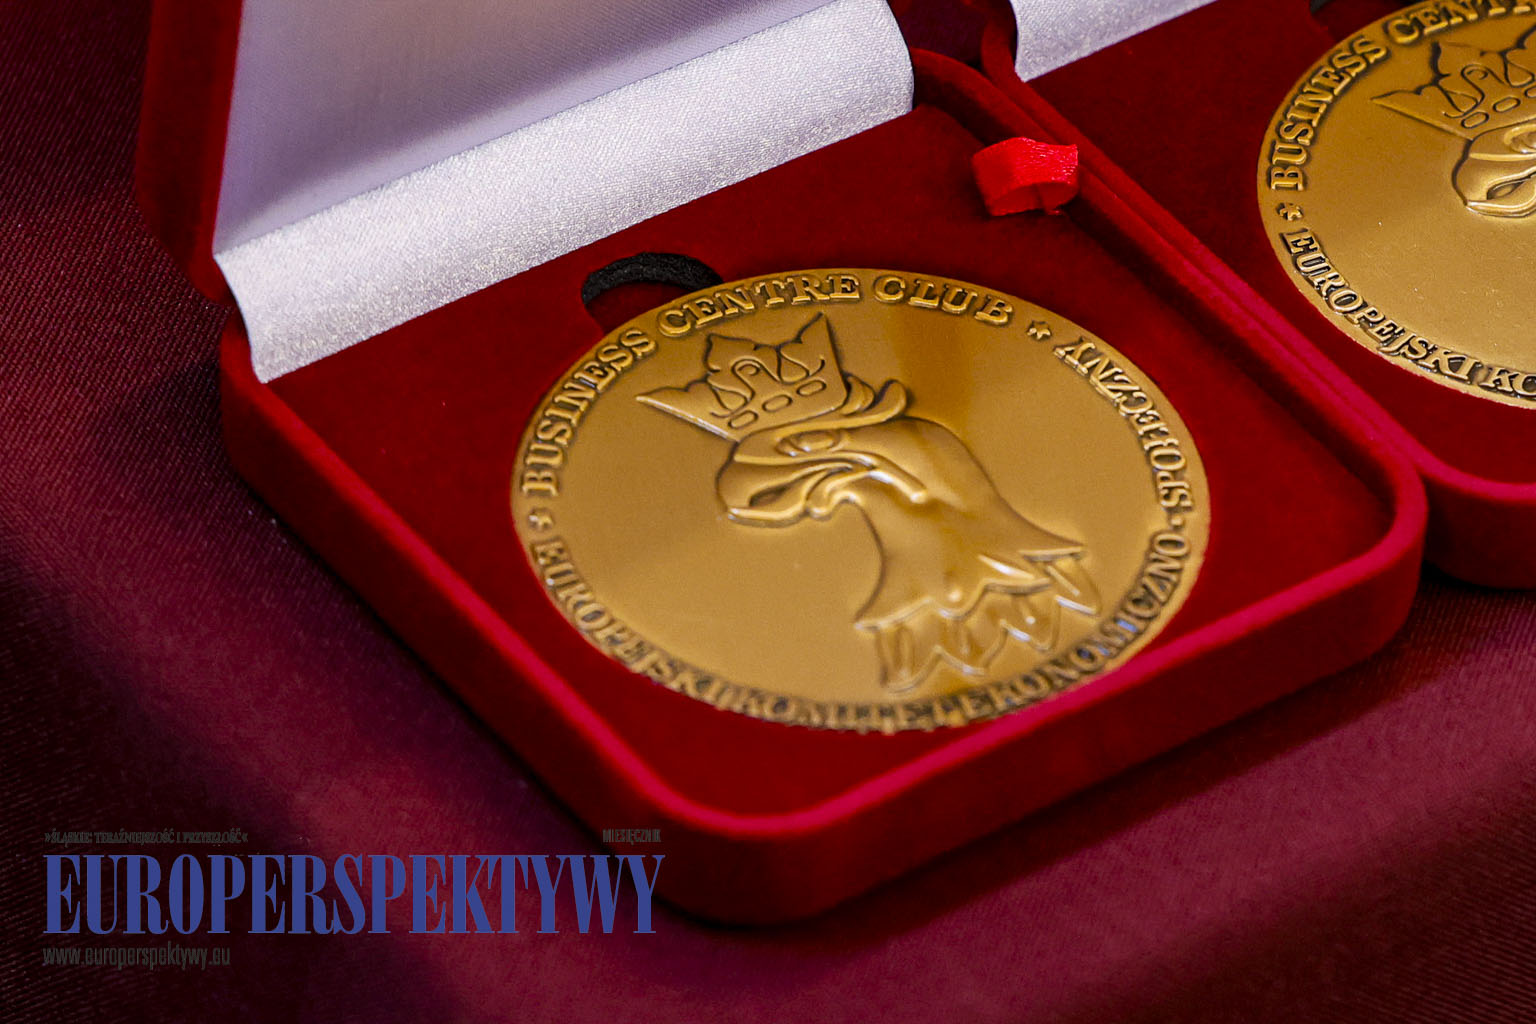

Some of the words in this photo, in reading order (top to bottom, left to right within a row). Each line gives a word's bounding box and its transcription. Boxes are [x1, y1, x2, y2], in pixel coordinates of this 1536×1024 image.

[1270, 33, 1389, 192] BUSINESS
[1281, 227, 1482, 384] EUROPEJSKI
[521, 328, 657, 497] BUSINESS
[657, 274, 862, 338] CENTRE
[873, 275, 1015, 326] CLUB
